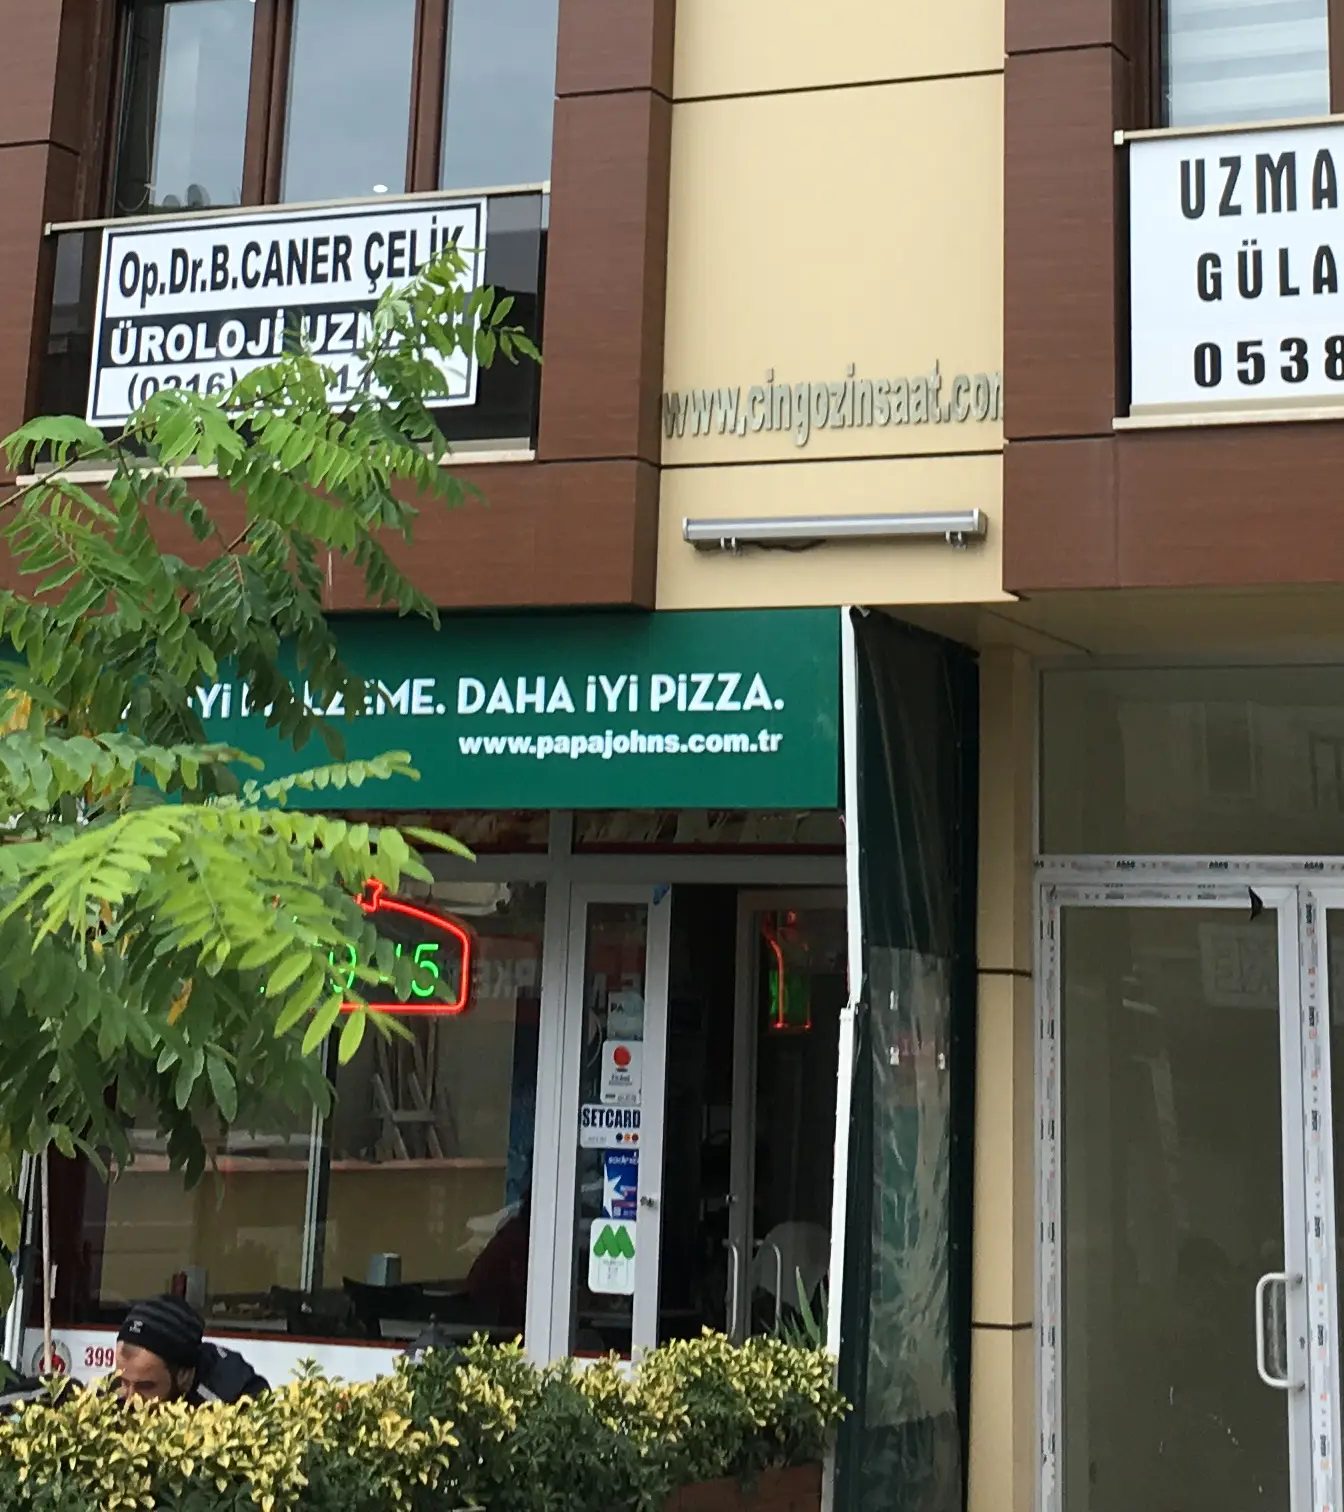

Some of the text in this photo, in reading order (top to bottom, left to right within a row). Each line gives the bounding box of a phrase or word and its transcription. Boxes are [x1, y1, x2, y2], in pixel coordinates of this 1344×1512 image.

[364, 215, 466, 293] ÇELİK
[110, 309, 284, 365] ÜROLOJİ
[457, 676, 575, 715] DAHA
[458, 729, 783, 759] www.papajohns.com.tr
[581, 1106, 641, 1130] SETCARD
